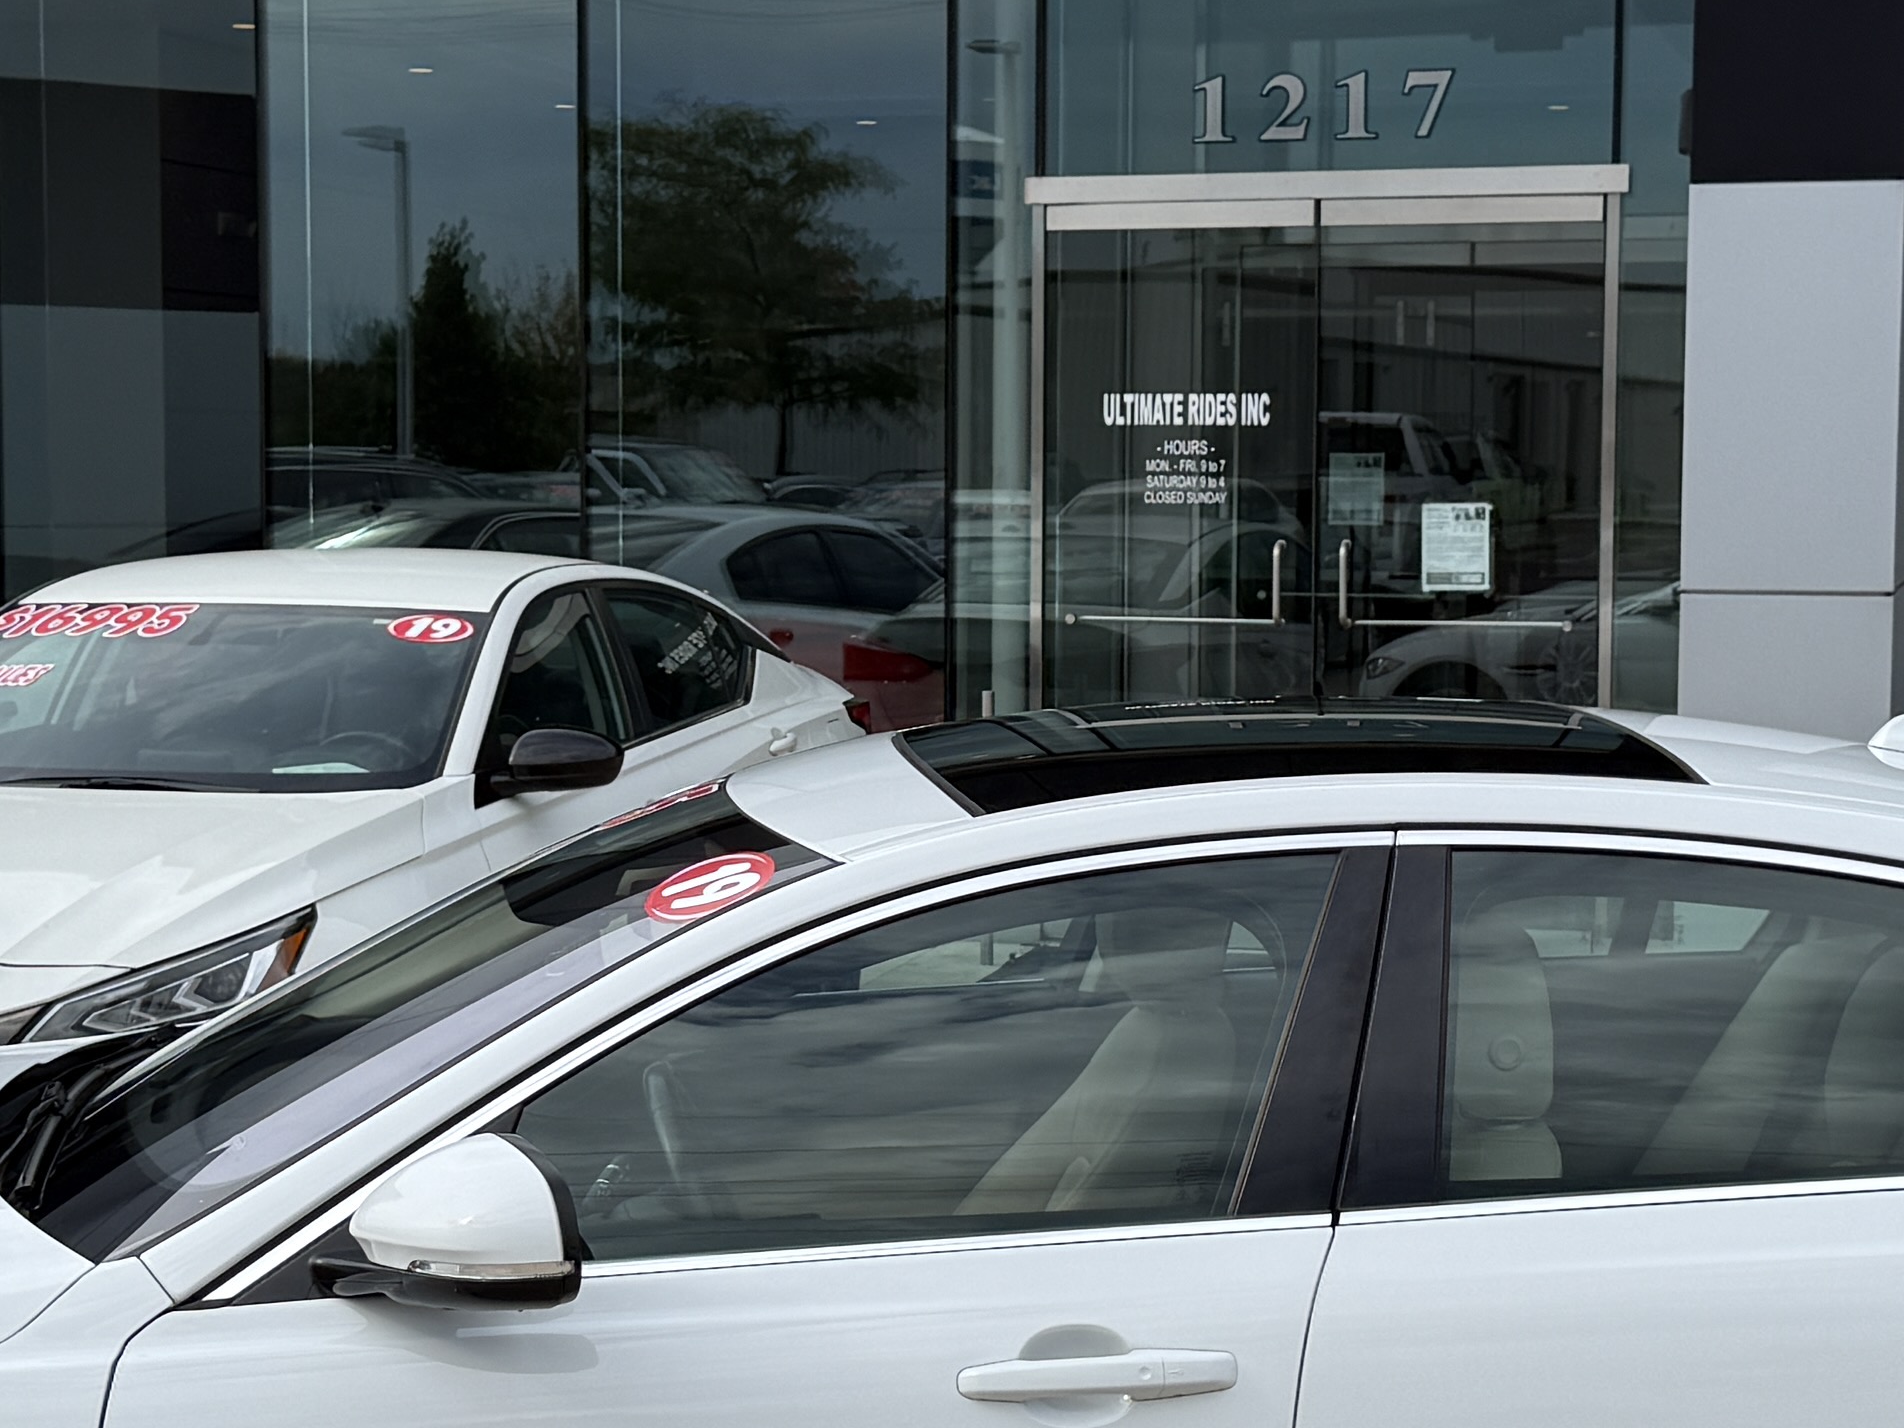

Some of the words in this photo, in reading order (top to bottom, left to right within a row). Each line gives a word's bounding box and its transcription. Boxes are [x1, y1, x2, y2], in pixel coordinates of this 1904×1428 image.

[1192, 69, 1455, 144] 1217
[1103, 392, 1184, 426] ULTIMATE
[1188, 392, 1237, 426] RIDES
[1241, 392, 1271, 426] INC
[1163, 439, 1209, 456] HOURS
[1219, 459, 1226, 472] 7
[1146, 474, 1197, 489] SATURDAY
[1218, 475, 1226, 488] 4
[1143, 491, 1185, 504] CLOSED
[1186, 491, 1228, 504] SUNDAY
[405, 615, 459, 640] 19
[661, 861, 762, 910] 19
